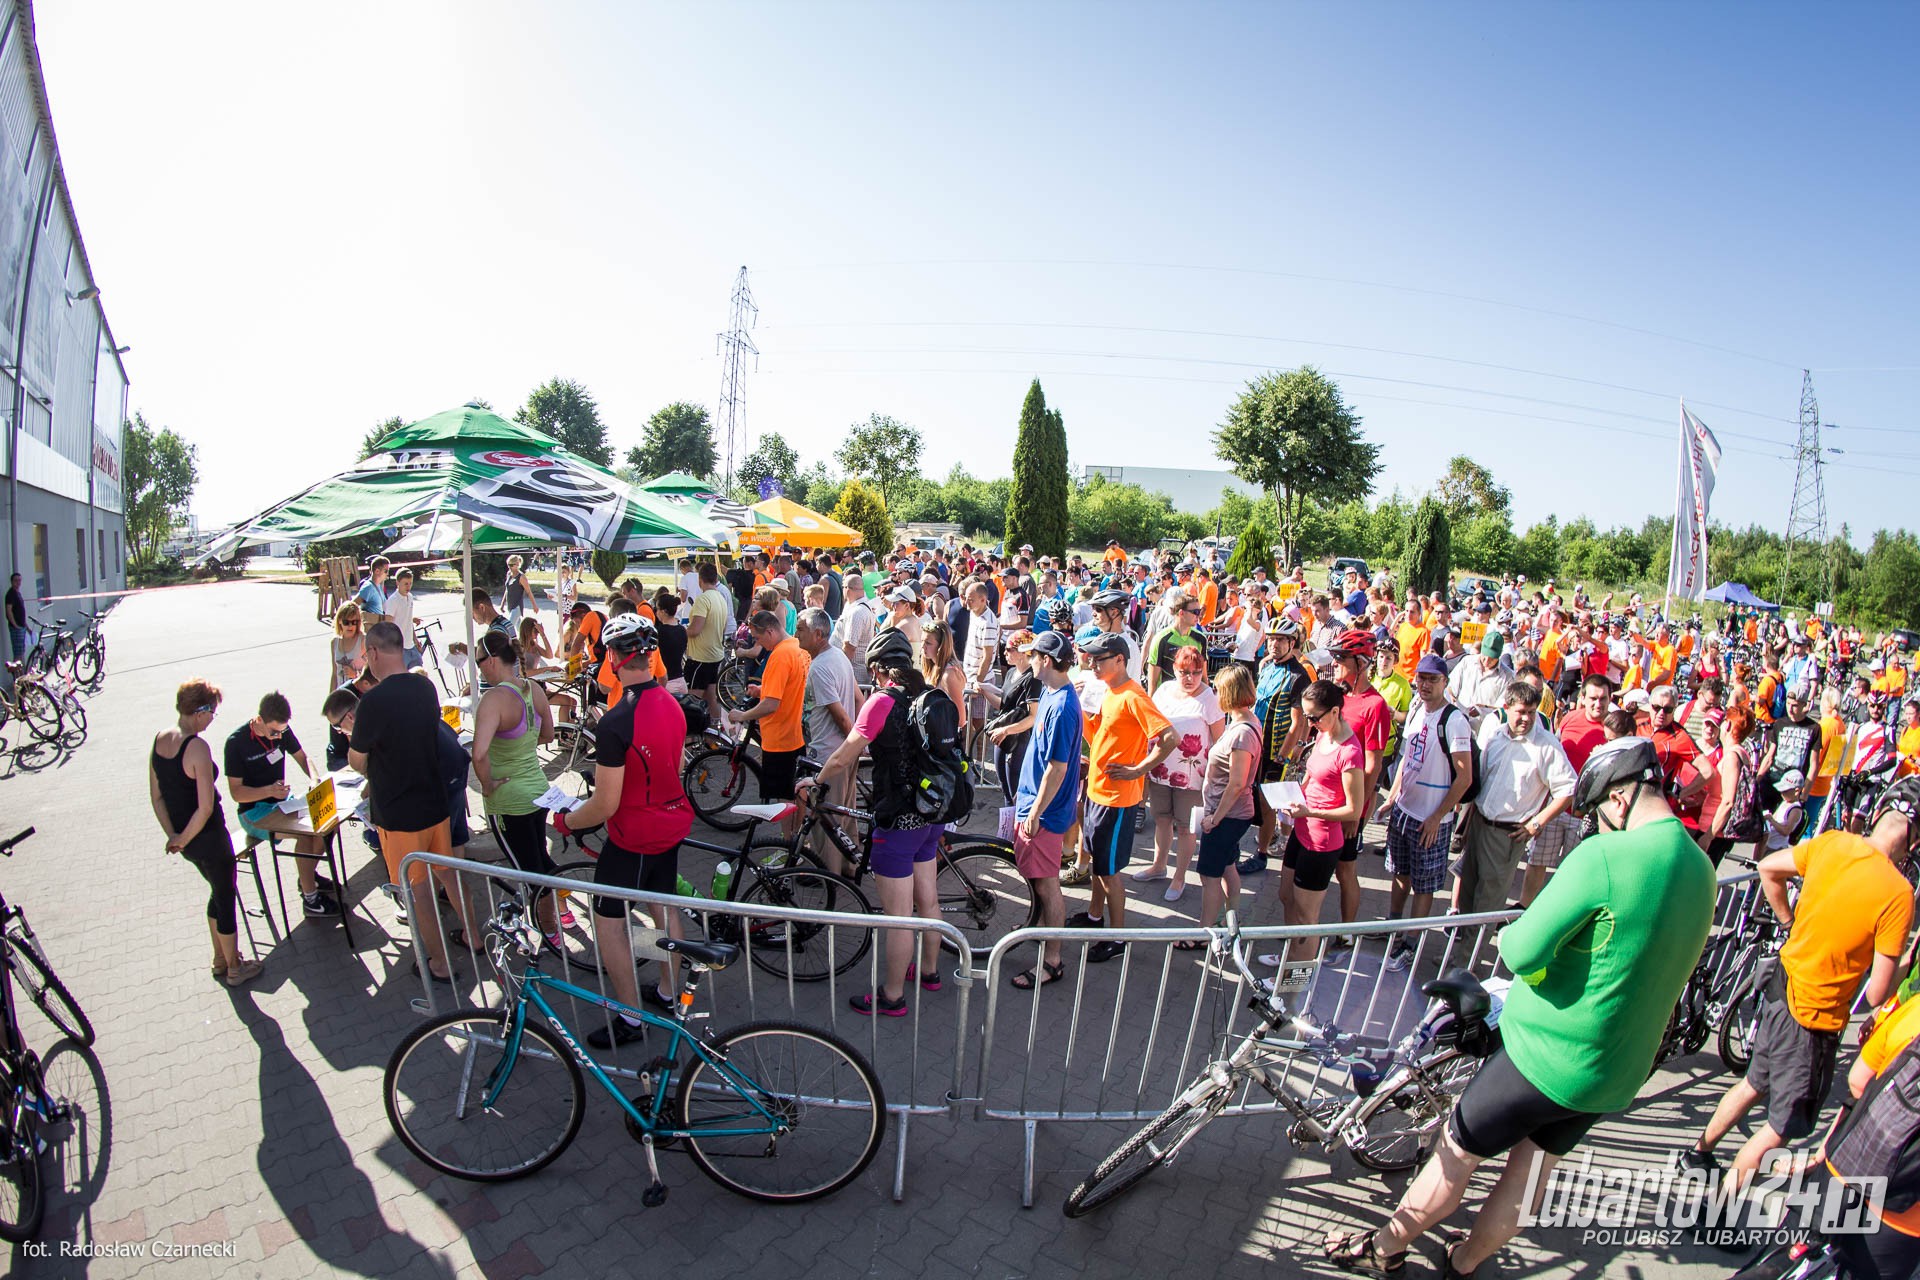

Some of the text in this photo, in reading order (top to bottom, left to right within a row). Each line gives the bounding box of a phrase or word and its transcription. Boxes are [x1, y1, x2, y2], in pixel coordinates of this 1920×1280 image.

[1686, 530, 1701, 588] BLACK
[1779, 727, 1811, 739] STAR
[548, 1016, 598, 1070] GIANT
[708, 1063, 737, 1088] GIANT
